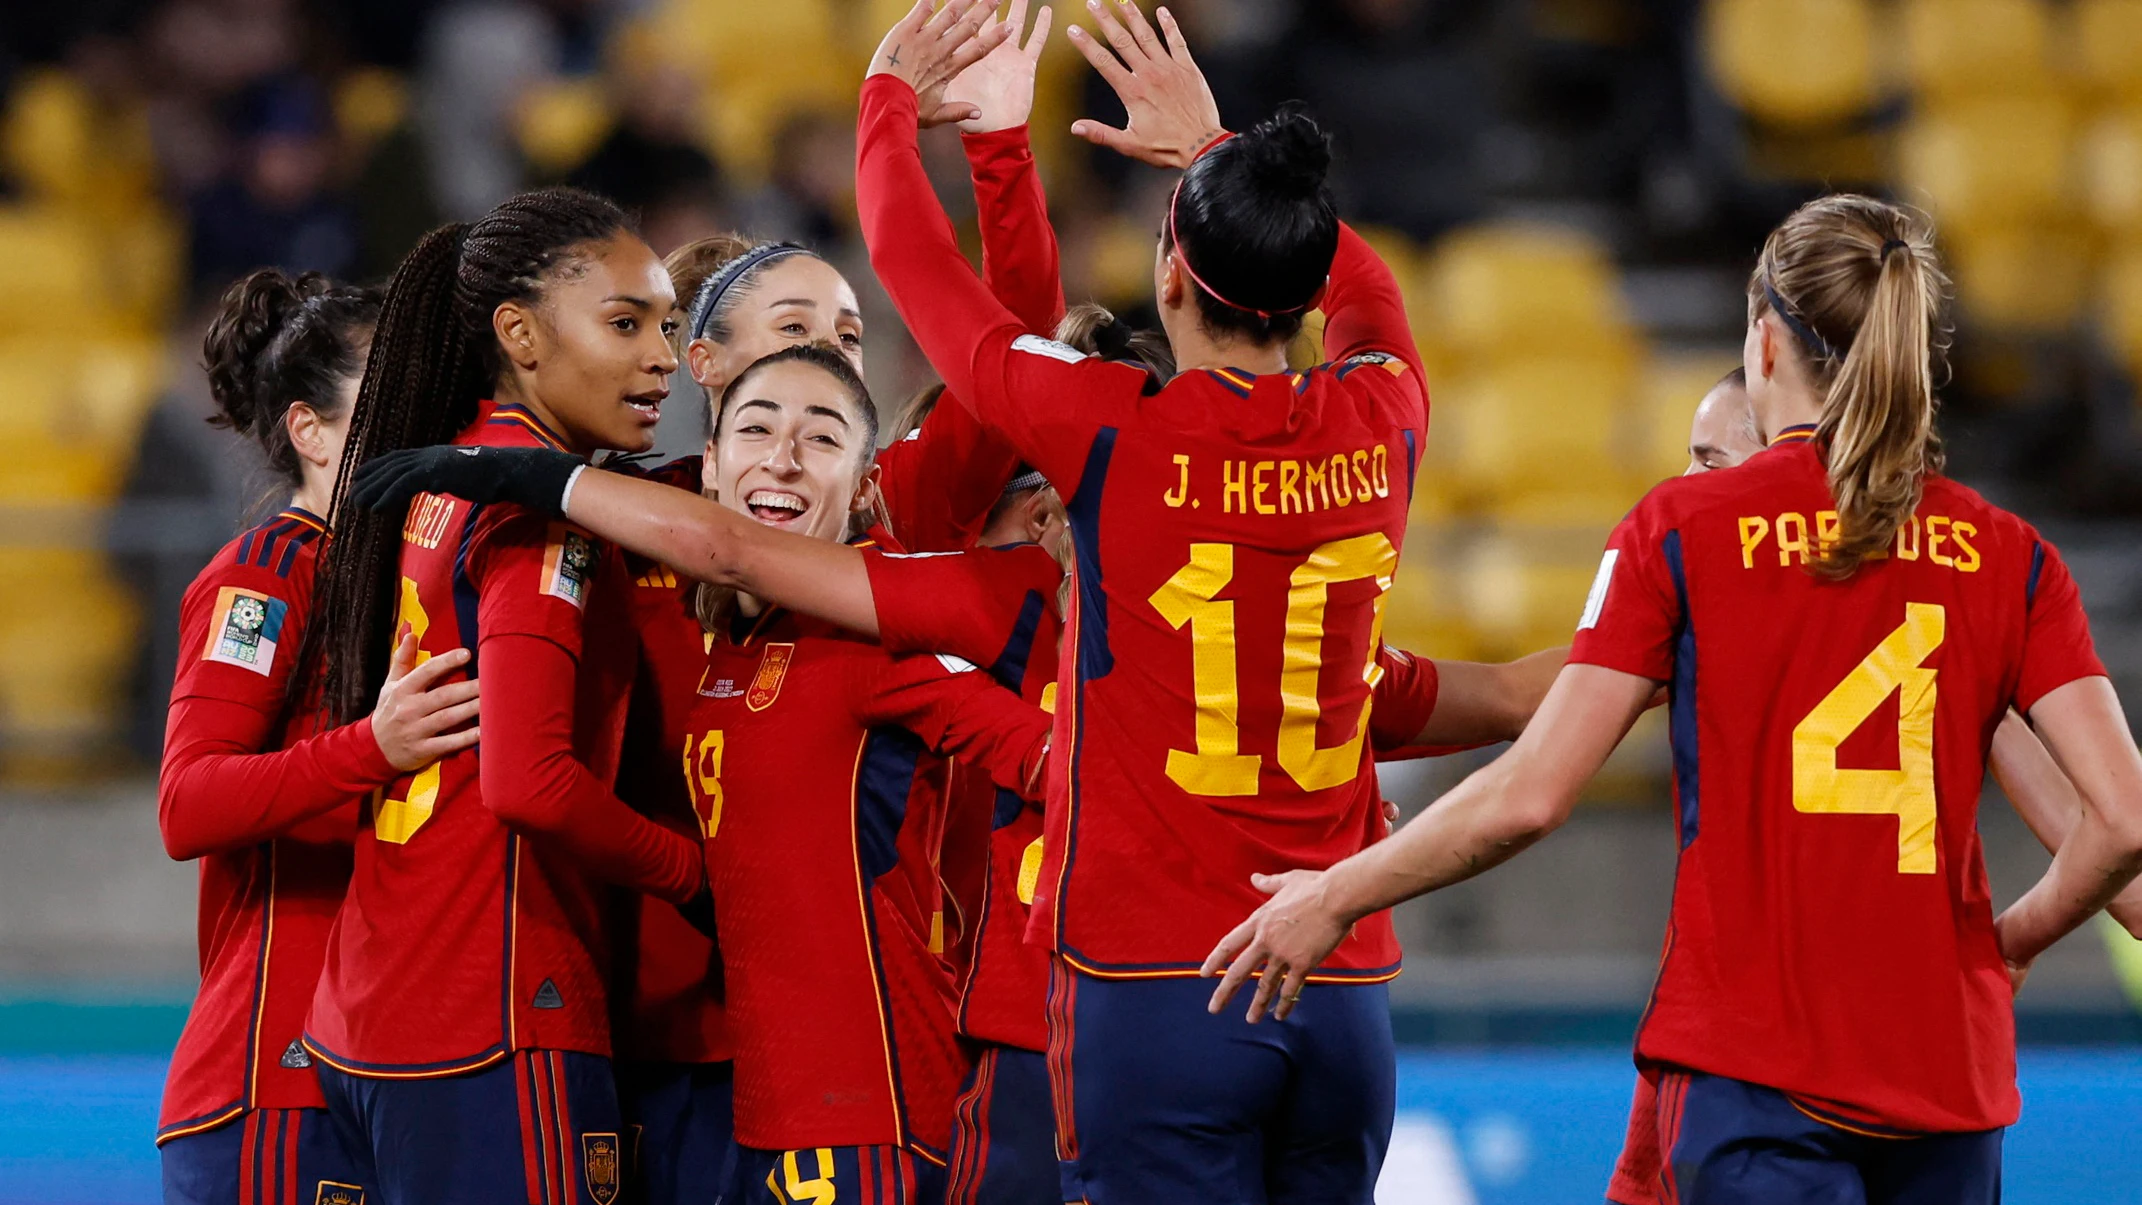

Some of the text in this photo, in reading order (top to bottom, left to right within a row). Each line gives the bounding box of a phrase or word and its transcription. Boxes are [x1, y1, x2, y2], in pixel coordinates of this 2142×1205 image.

[1164, 444, 1390, 515] J. HERMOSO
[1738, 509, 1981, 573] PARDES
[1148, 532, 1398, 797] 10
[1792, 602, 1945, 874] 4
